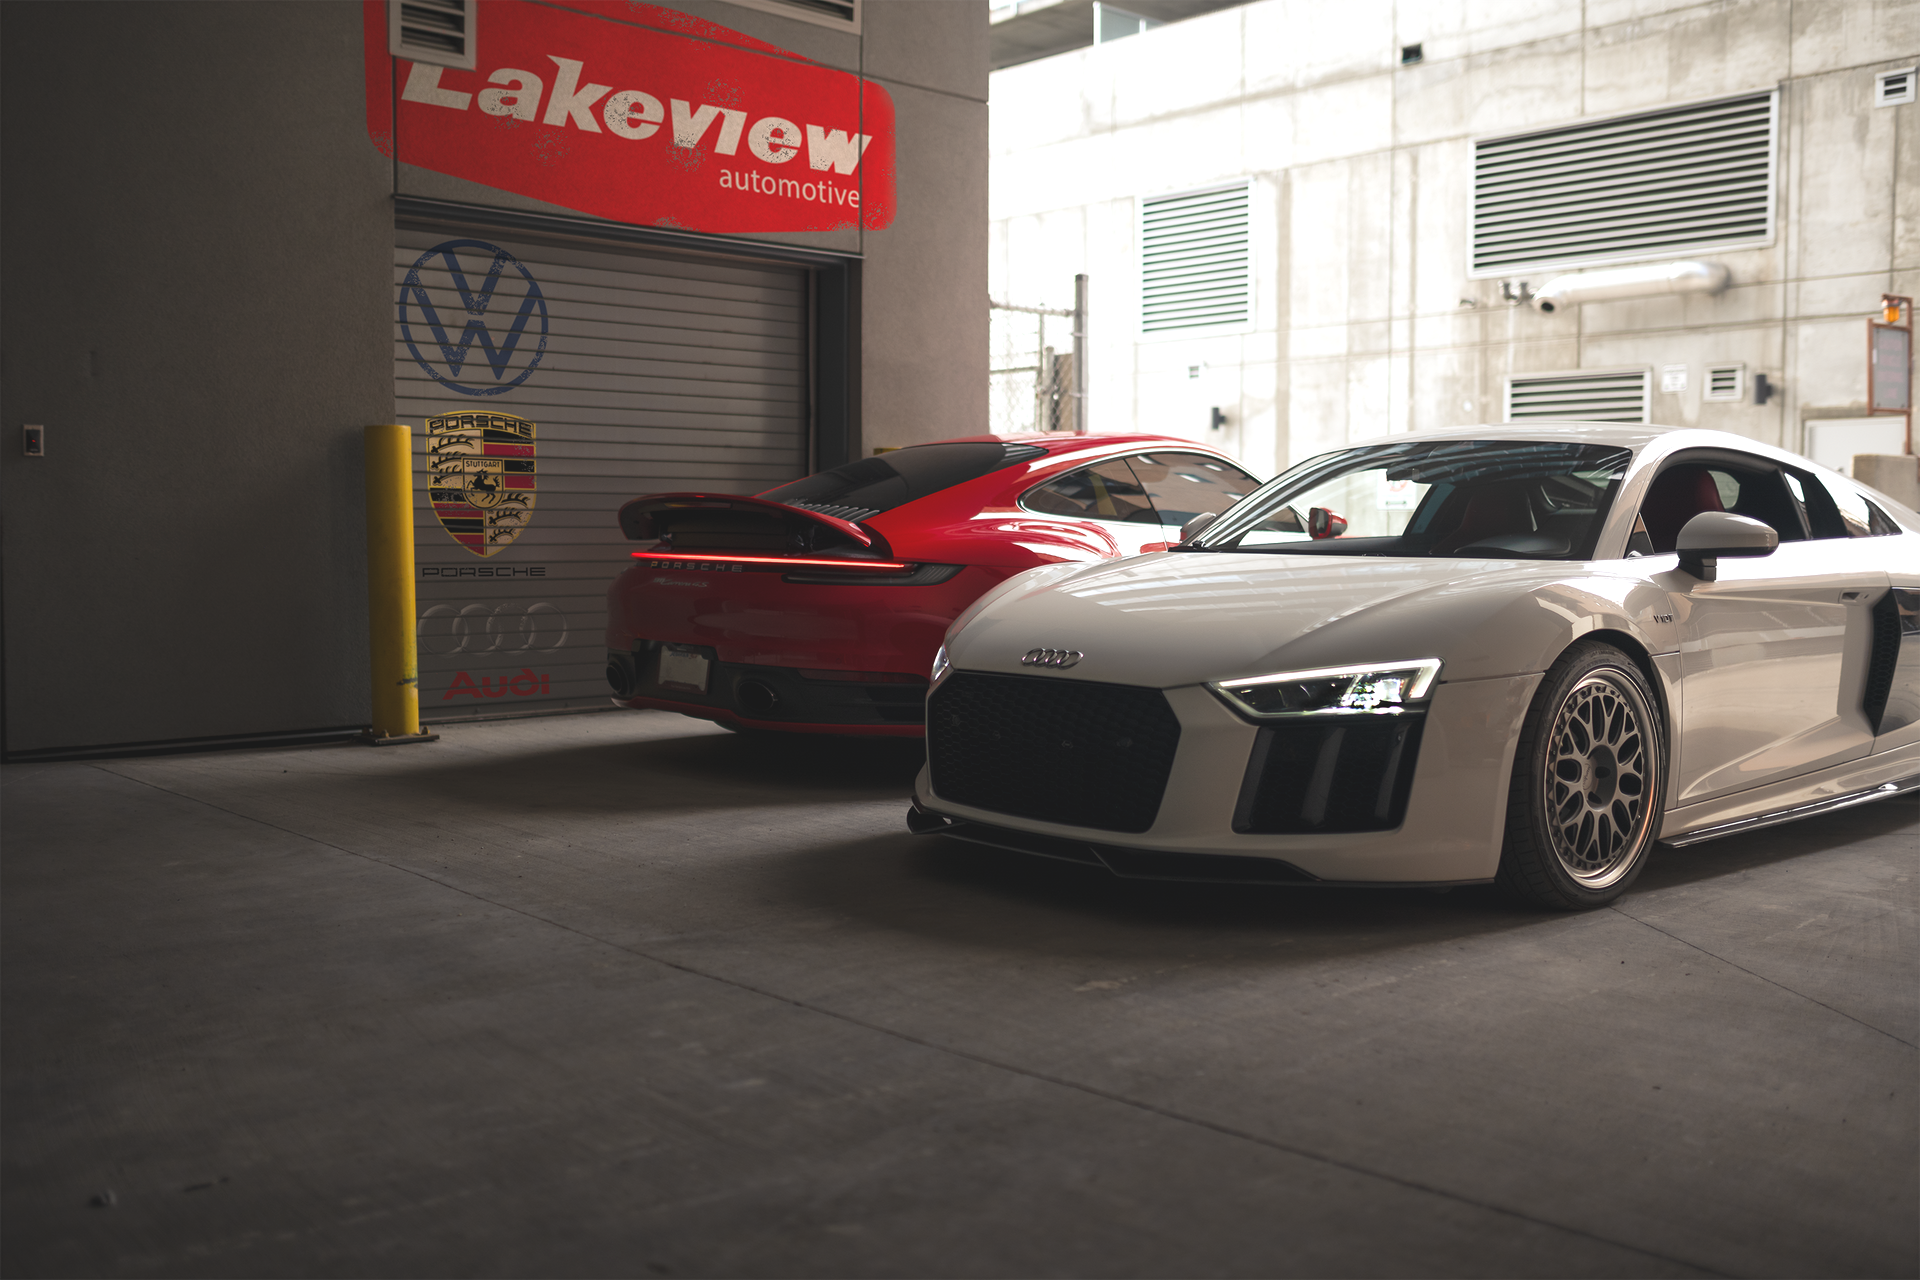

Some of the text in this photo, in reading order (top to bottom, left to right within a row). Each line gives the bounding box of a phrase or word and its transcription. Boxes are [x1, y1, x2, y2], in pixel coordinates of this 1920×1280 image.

[401, 54, 873, 176] Lakeview
[719, 168, 860, 208] automotive
[429, 414, 533, 439] PORSCHE
[465, 460, 501, 468] STUTTGART
[422, 567, 546, 577] PORSCHE
[651, 561, 743, 573] PORSCHE
[442, 668, 550, 700] Audi
